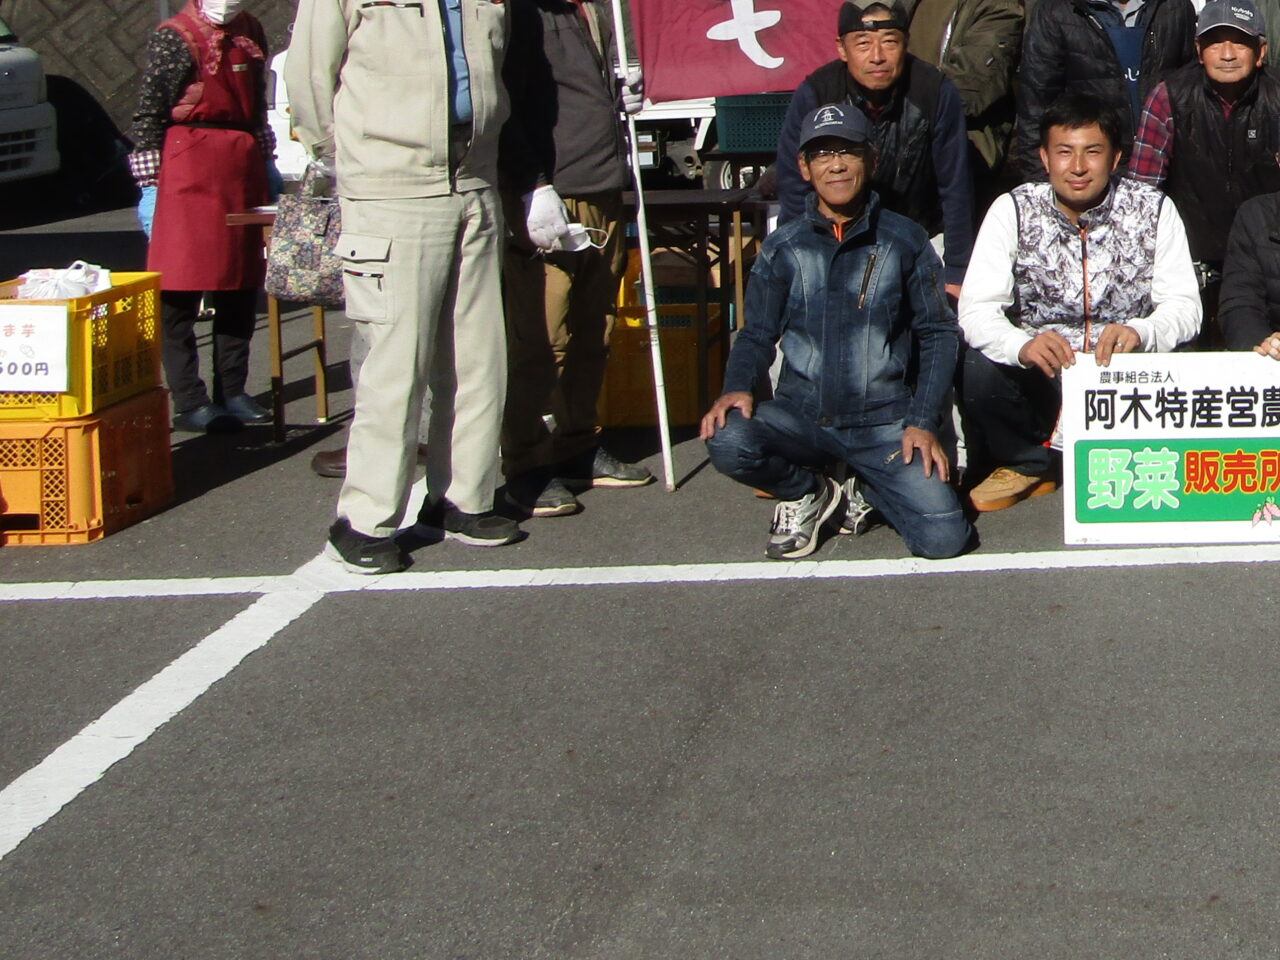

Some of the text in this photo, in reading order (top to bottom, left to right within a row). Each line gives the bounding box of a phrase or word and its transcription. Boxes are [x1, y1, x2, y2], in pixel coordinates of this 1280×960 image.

[1099, 370, 1175, 384] 農事組合法人
